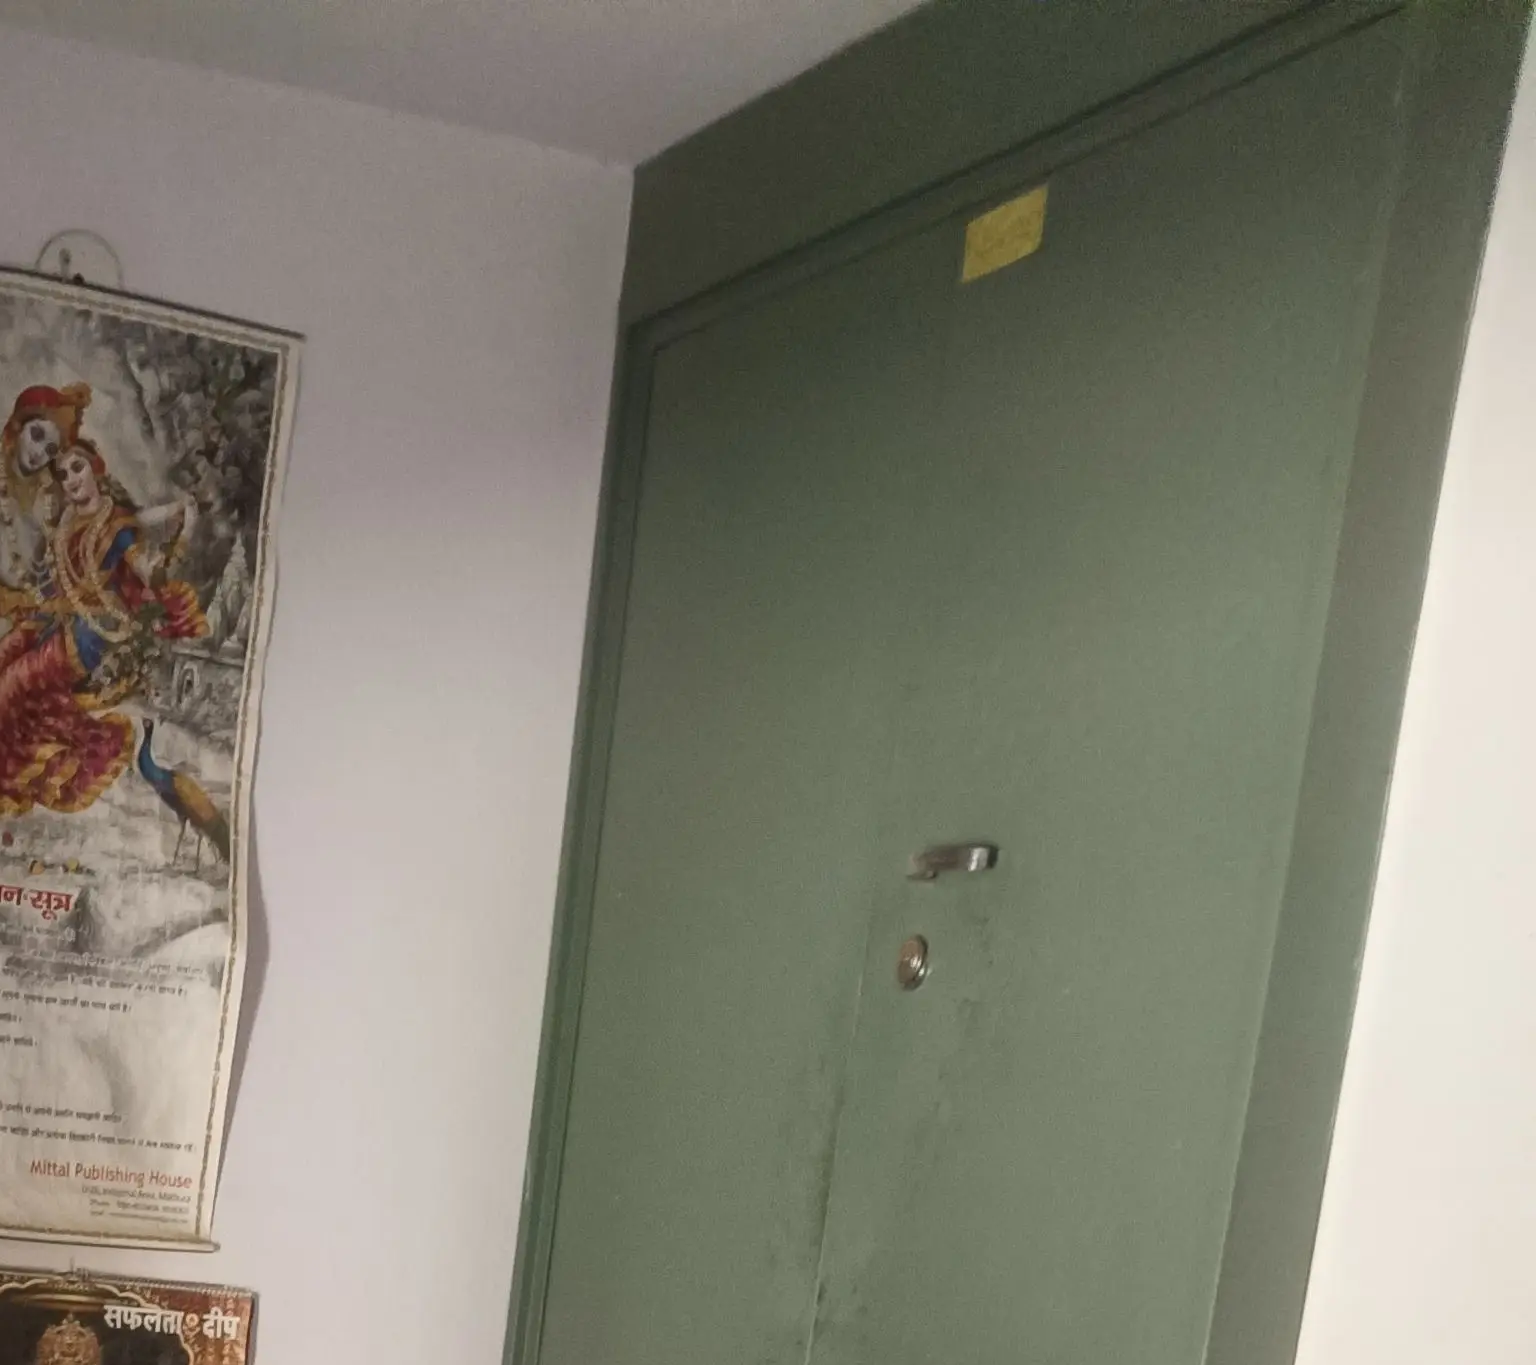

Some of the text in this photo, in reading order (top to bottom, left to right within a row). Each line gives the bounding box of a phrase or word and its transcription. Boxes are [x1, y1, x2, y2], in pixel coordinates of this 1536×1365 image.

[30, 1160, 193, 1189] Mittal Publishing House
[103, 1305, 240, 1341] सफलता दीप
